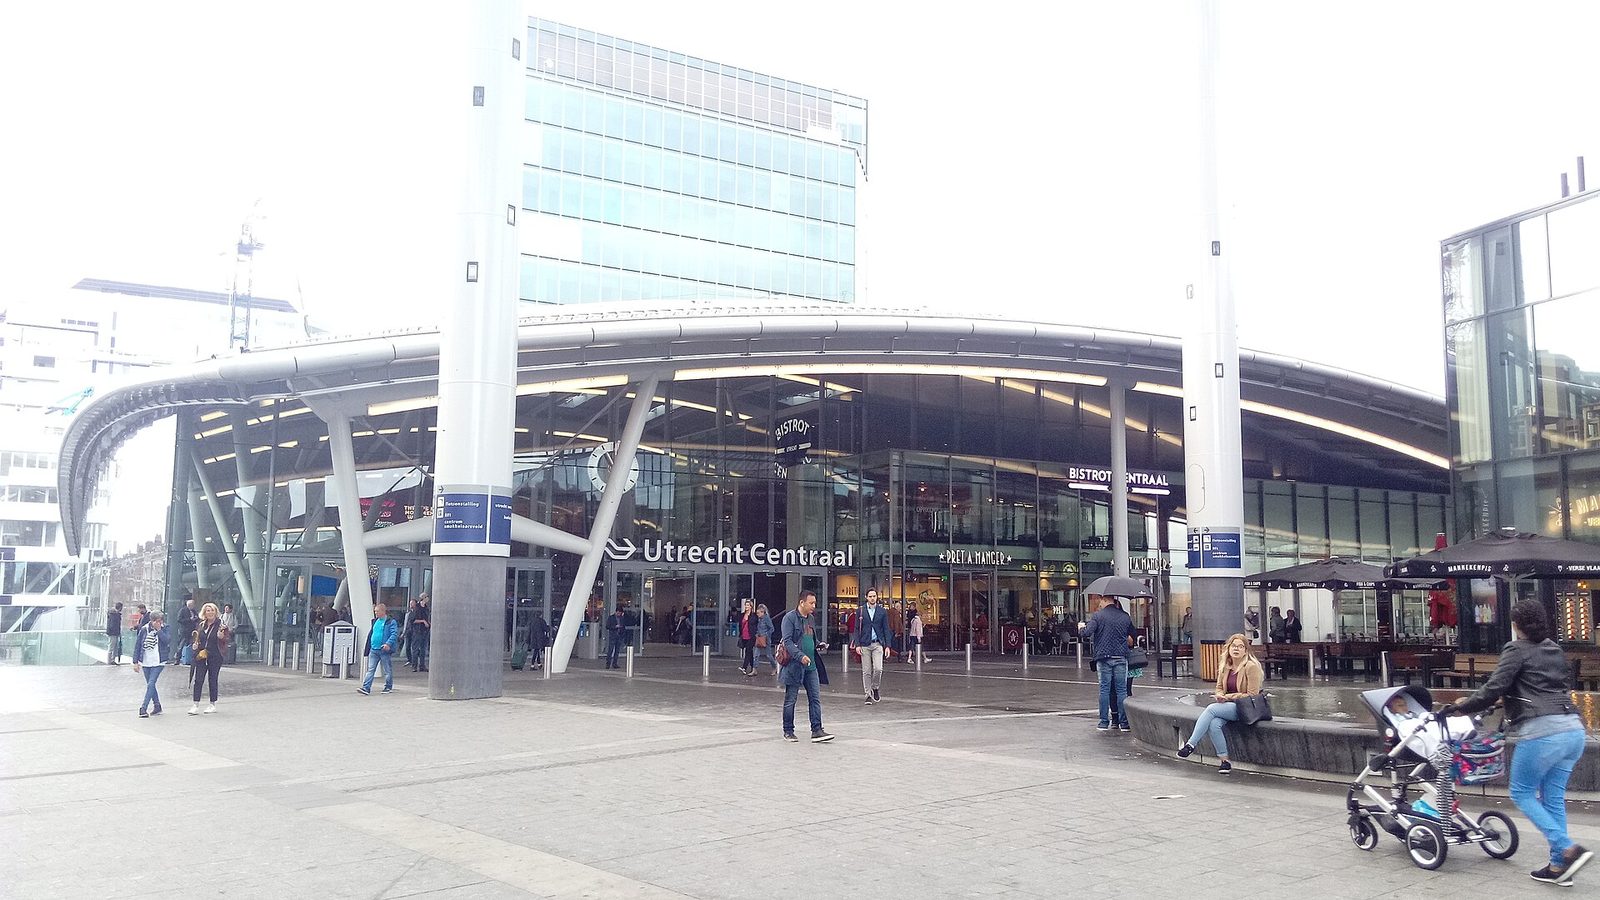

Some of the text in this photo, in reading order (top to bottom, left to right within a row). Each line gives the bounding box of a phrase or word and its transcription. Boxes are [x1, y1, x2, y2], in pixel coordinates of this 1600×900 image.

[775, 418, 810, 441] BISTROT
[1069, 467, 1169, 486] BISTROT ENTRAAL
[644, 539, 853, 567] Utrecht Centraal
[946, 550, 1006, 566] PRET A MANGER
[1447, 564, 1493, 573] MANNEKENPIS
